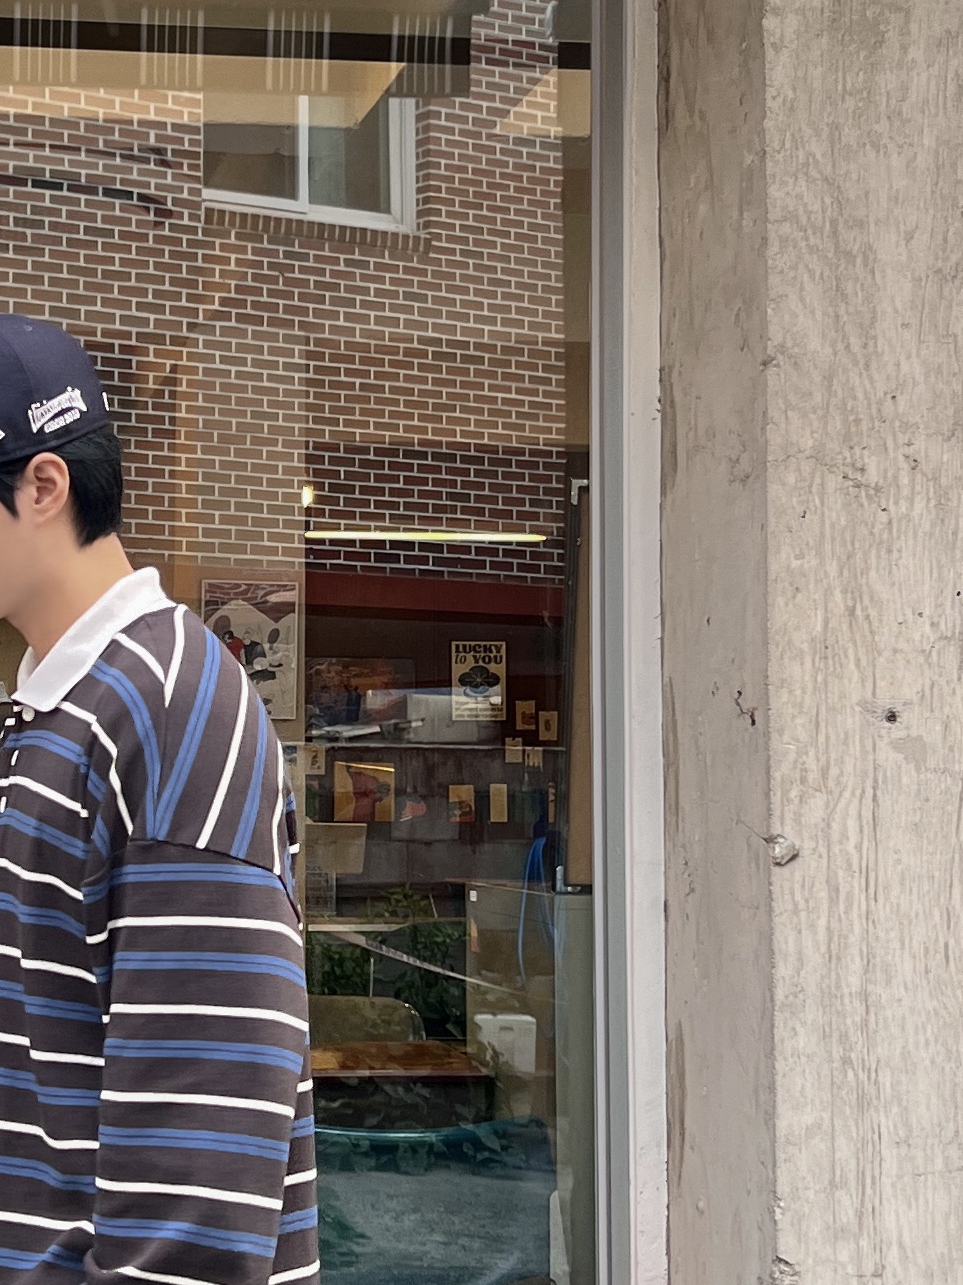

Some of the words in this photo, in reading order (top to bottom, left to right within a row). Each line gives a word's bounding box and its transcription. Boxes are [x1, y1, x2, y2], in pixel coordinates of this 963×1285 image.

[454, 644, 503, 654] LUCKY
[454, 654, 467, 664] to
[472, 654, 503, 664] YOU
